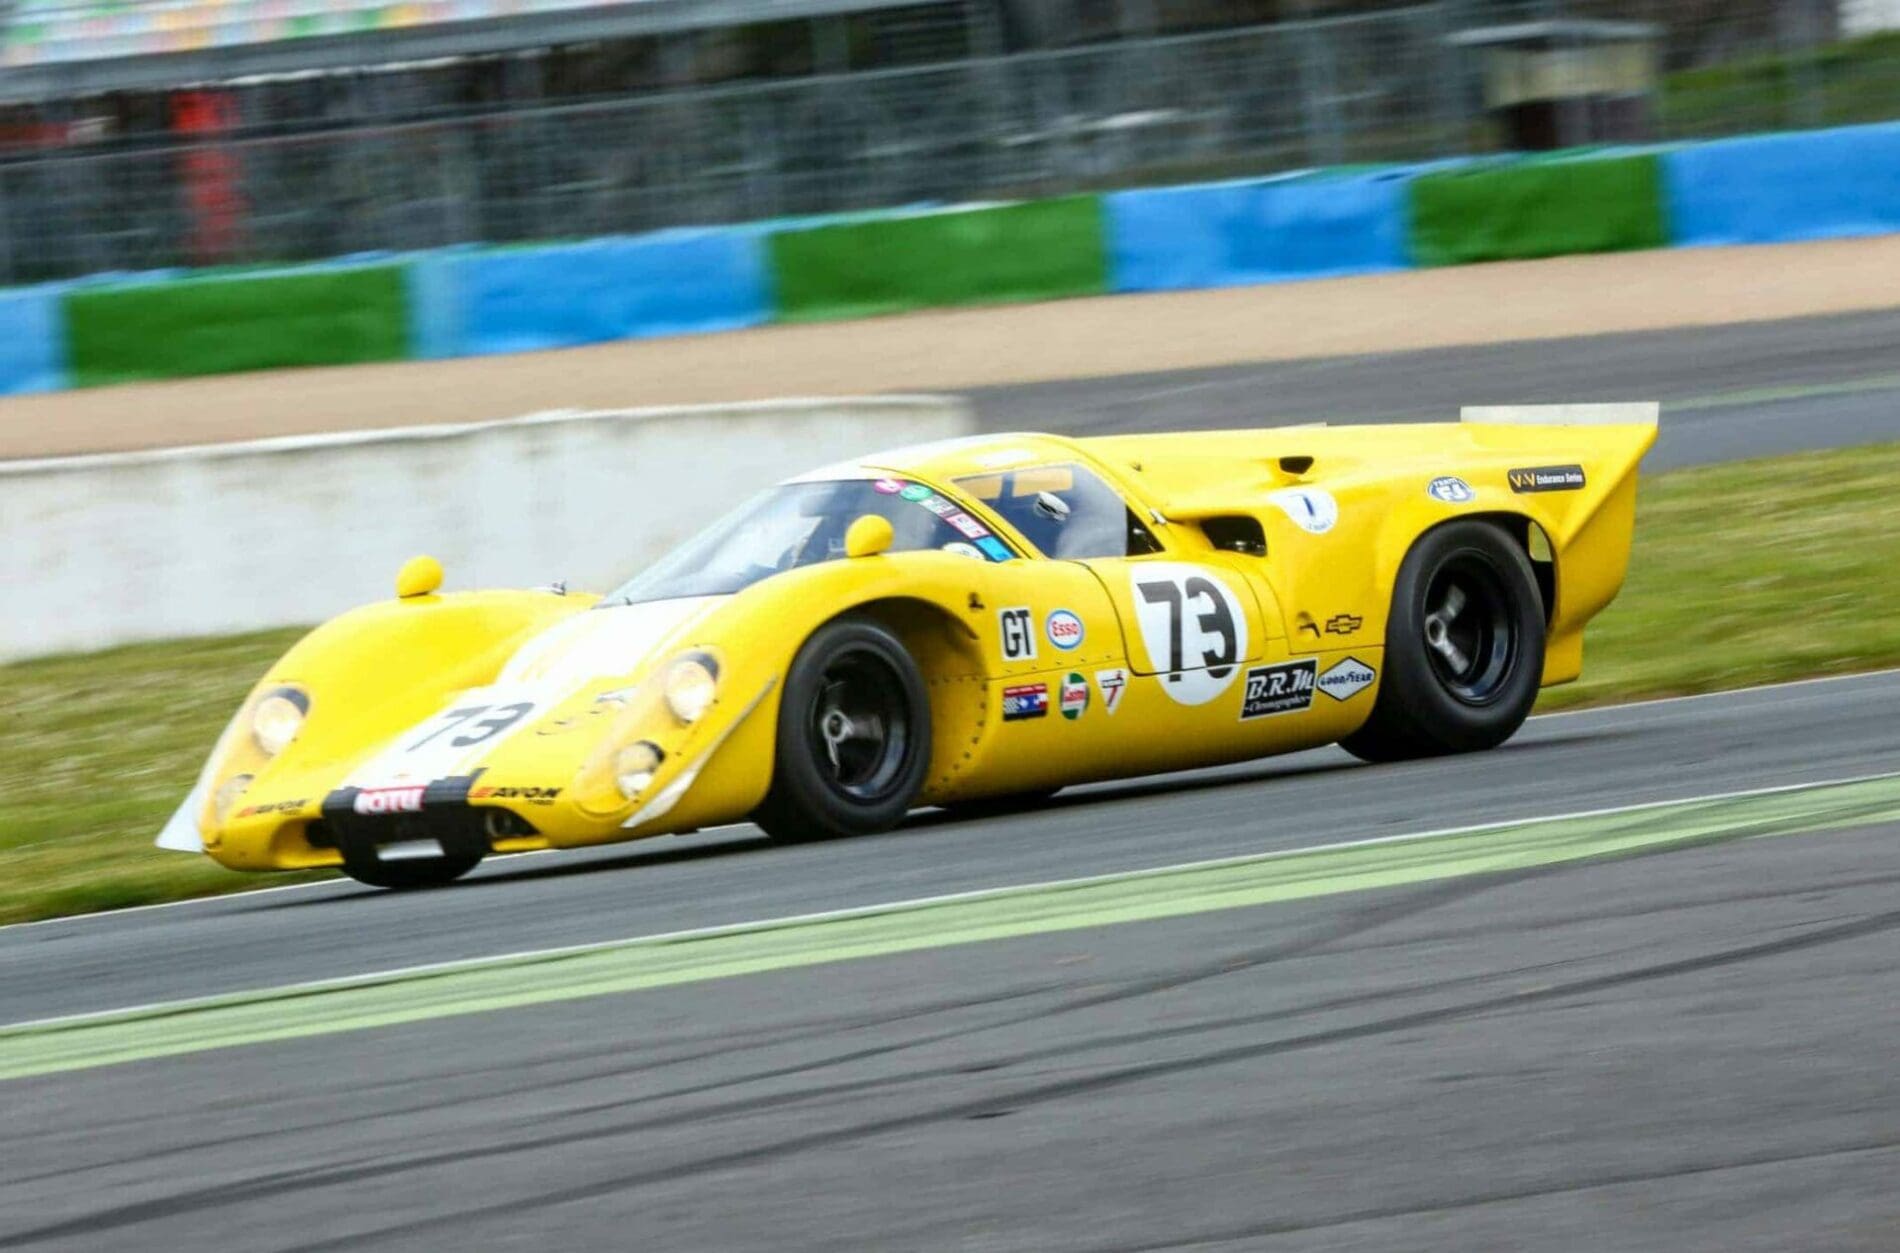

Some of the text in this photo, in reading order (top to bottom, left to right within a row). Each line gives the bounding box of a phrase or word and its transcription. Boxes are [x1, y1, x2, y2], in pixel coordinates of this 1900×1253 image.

[1002, 609, 1032, 658] GT
[1051, 621, 1078, 637] Esso
[1136, 577, 1237, 682] 73
[406, 702, 535, 753] 73
